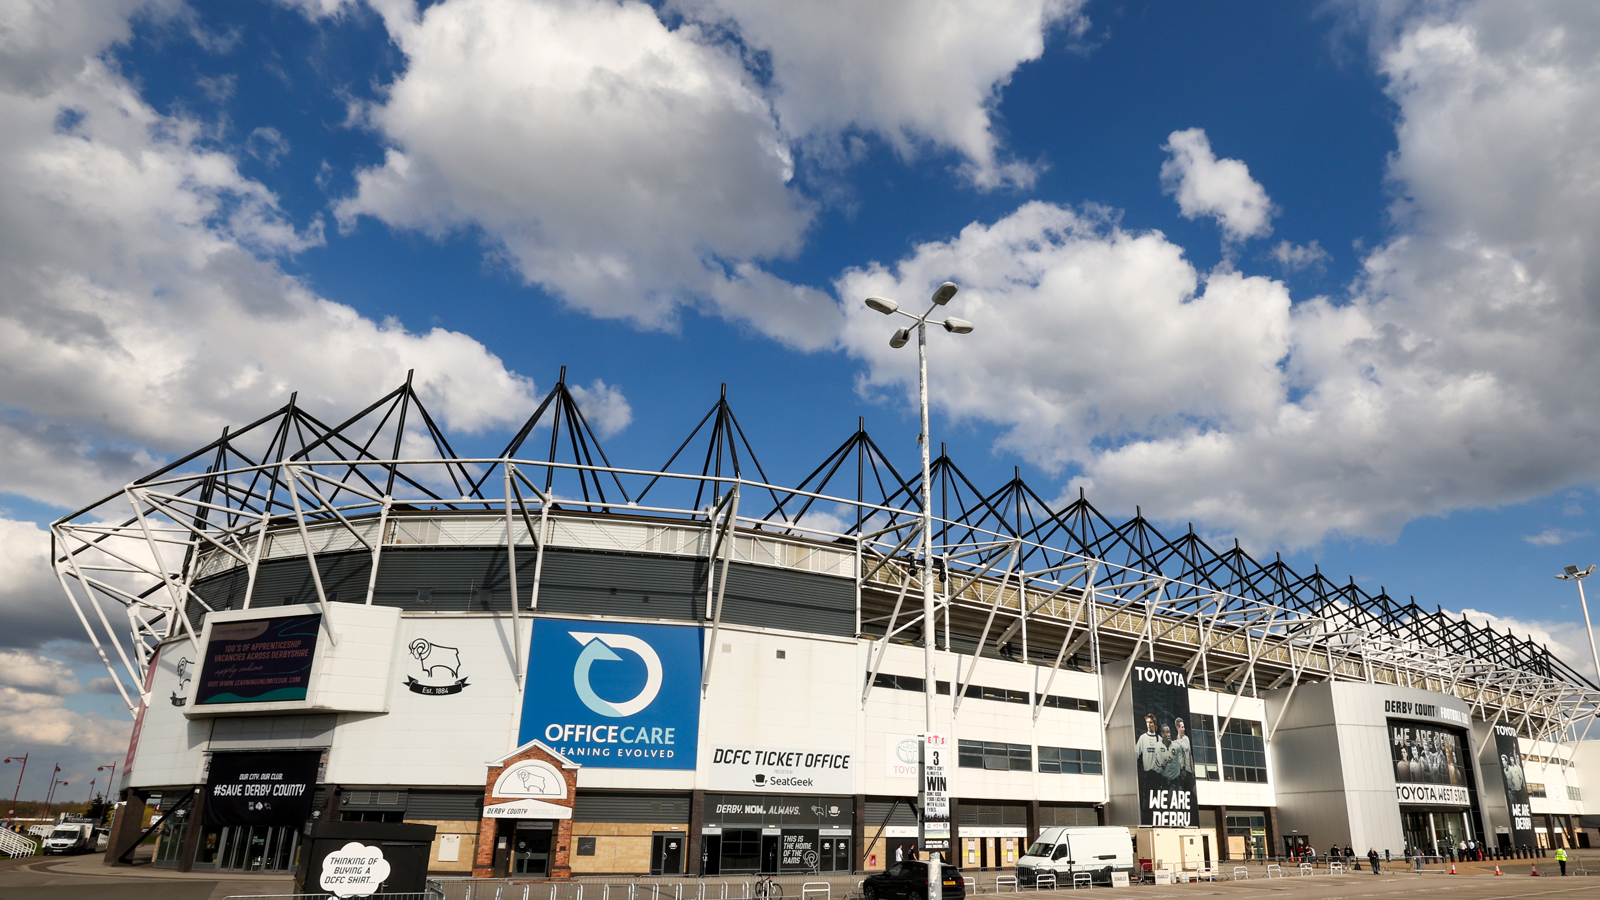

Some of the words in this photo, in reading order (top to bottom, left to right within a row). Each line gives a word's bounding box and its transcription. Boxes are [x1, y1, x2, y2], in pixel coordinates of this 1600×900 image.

[225, 644, 242, 653] 100'S
[242, 643, 251, 652] OF
[251, 640, 302, 651] APPRENTICESHIP
[214, 654, 246, 663] VACANCIES
[246, 651, 272, 661] ACROSS
[271, 648, 309, 658] DERBYSHIRE
[1135, 666, 1186, 688] TOYOTA
[421, 686, 434, 694] Est.
[1385, 700, 1413, 715] DERBY
[1415, 703, 1439, 717] COUNTY
[544, 723, 676, 745] OFFICECARE
[1393, 727, 1410, 747] WE
[1495, 725, 1517, 738] TOYOTA
[553, 746, 610, 757] LEANING
[617, 748, 675, 758] EVOLVED
[713, 748, 752, 765] DCFC
[755, 750, 803, 767] TICKET
[804, 753, 851, 769] OFFICE
[933, 750, 939, 766] 3
[893, 765, 918, 775] TOYO
[770, 776, 813, 787] SeatGeek
[926, 776, 947, 792] WIN
[213, 784, 243, 796] #SAVE
[244, 784, 272, 796] DERBY
[272, 784, 306, 796] COUNTY
[1396, 786, 1437, 801] TOYOTA
[1437, 788, 1453, 802] WEST
[1149, 789, 1169, 809] WE
[1170, 790, 1191, 810] ARE
[716, 804, 743, 814] DERBY.
[744, 805, 767, 814] NOW.
[768, 806, 801, 815] ALWAYS.
[1512, 803, 1522, 817] WE
[1152, 810, 1191, 826] DERBY
[330, 857, 366, 865] THINKING
[324, 876, 346, 884] DCFC
[347, 876, 376, 884] SHIRT...
